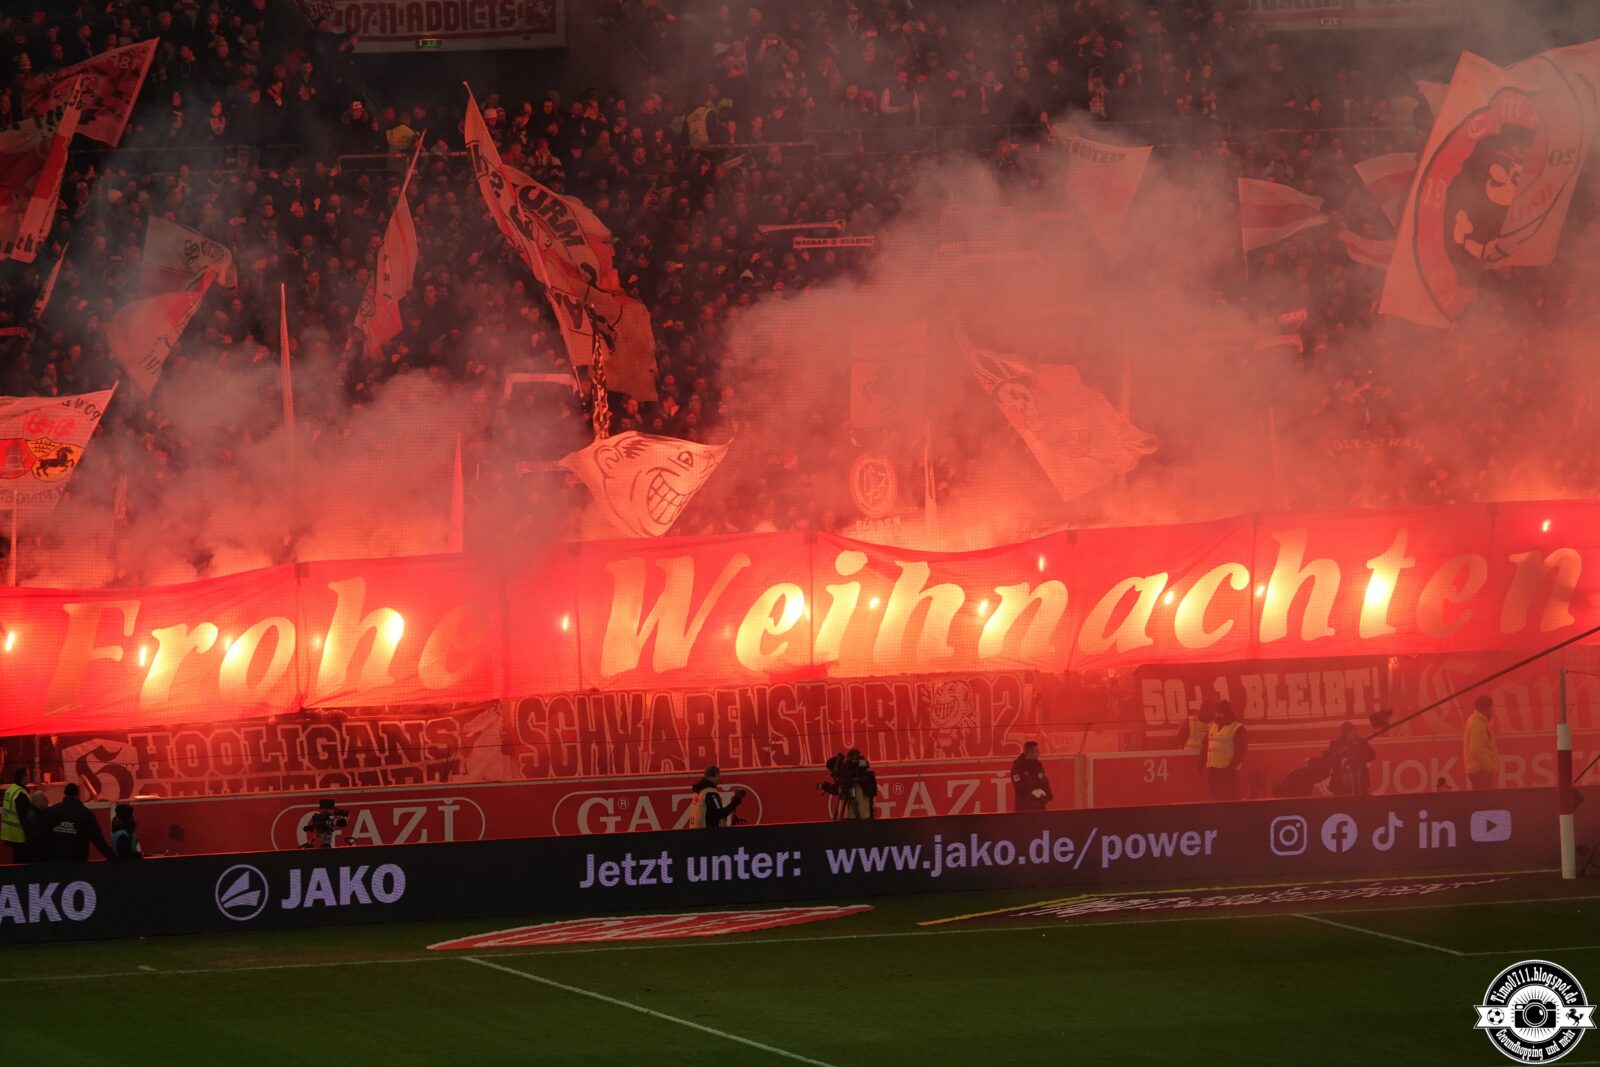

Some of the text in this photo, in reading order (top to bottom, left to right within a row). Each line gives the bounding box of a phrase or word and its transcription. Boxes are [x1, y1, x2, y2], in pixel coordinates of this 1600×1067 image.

[600, 527, 1583, 673] Weihnachten
[1241, 666, 1380, 721] BLEIBT!
[127, 717, 461, 781] HOOLIGANS
[514, 679, 931, 780] SCHWABENSTURM
[1143, 758, 1169, 783] 34
[281, 863, 406, 909] JAKO
[579, 827, 1218, 889] Jetzt unter: www.jako.de/power
[0, 880, 97, 925] AKO
